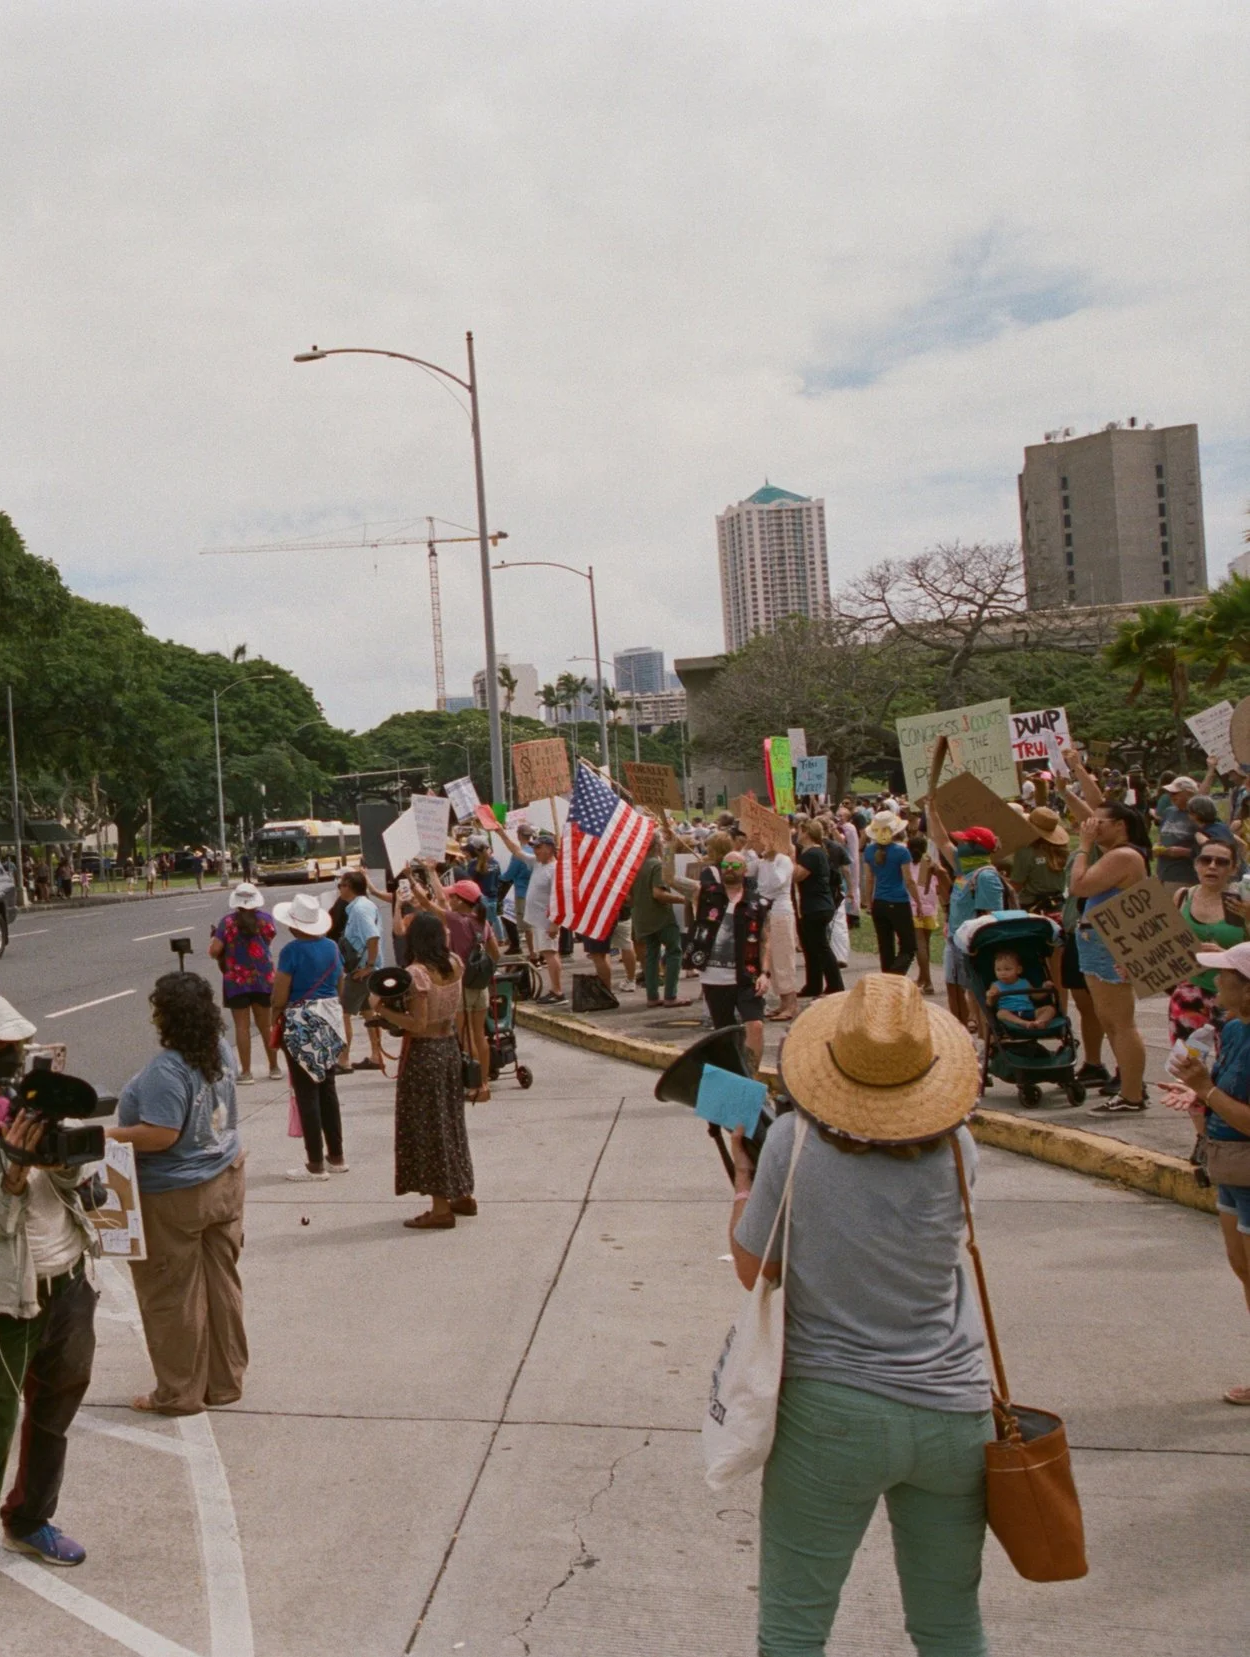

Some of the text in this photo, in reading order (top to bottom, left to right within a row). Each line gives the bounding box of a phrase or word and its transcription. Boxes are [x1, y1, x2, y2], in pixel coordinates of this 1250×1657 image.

[1013, 709, 1061, 739] DUMP
[968, 733, 990, 751] THE
[1012, 734, 1065, 760] TRUP
[1093, 888, 1152, 936] FU GOP
[1113, 935, 1133, 956] I
[1124, 929, 1195, 978] DO WHAT YOU
